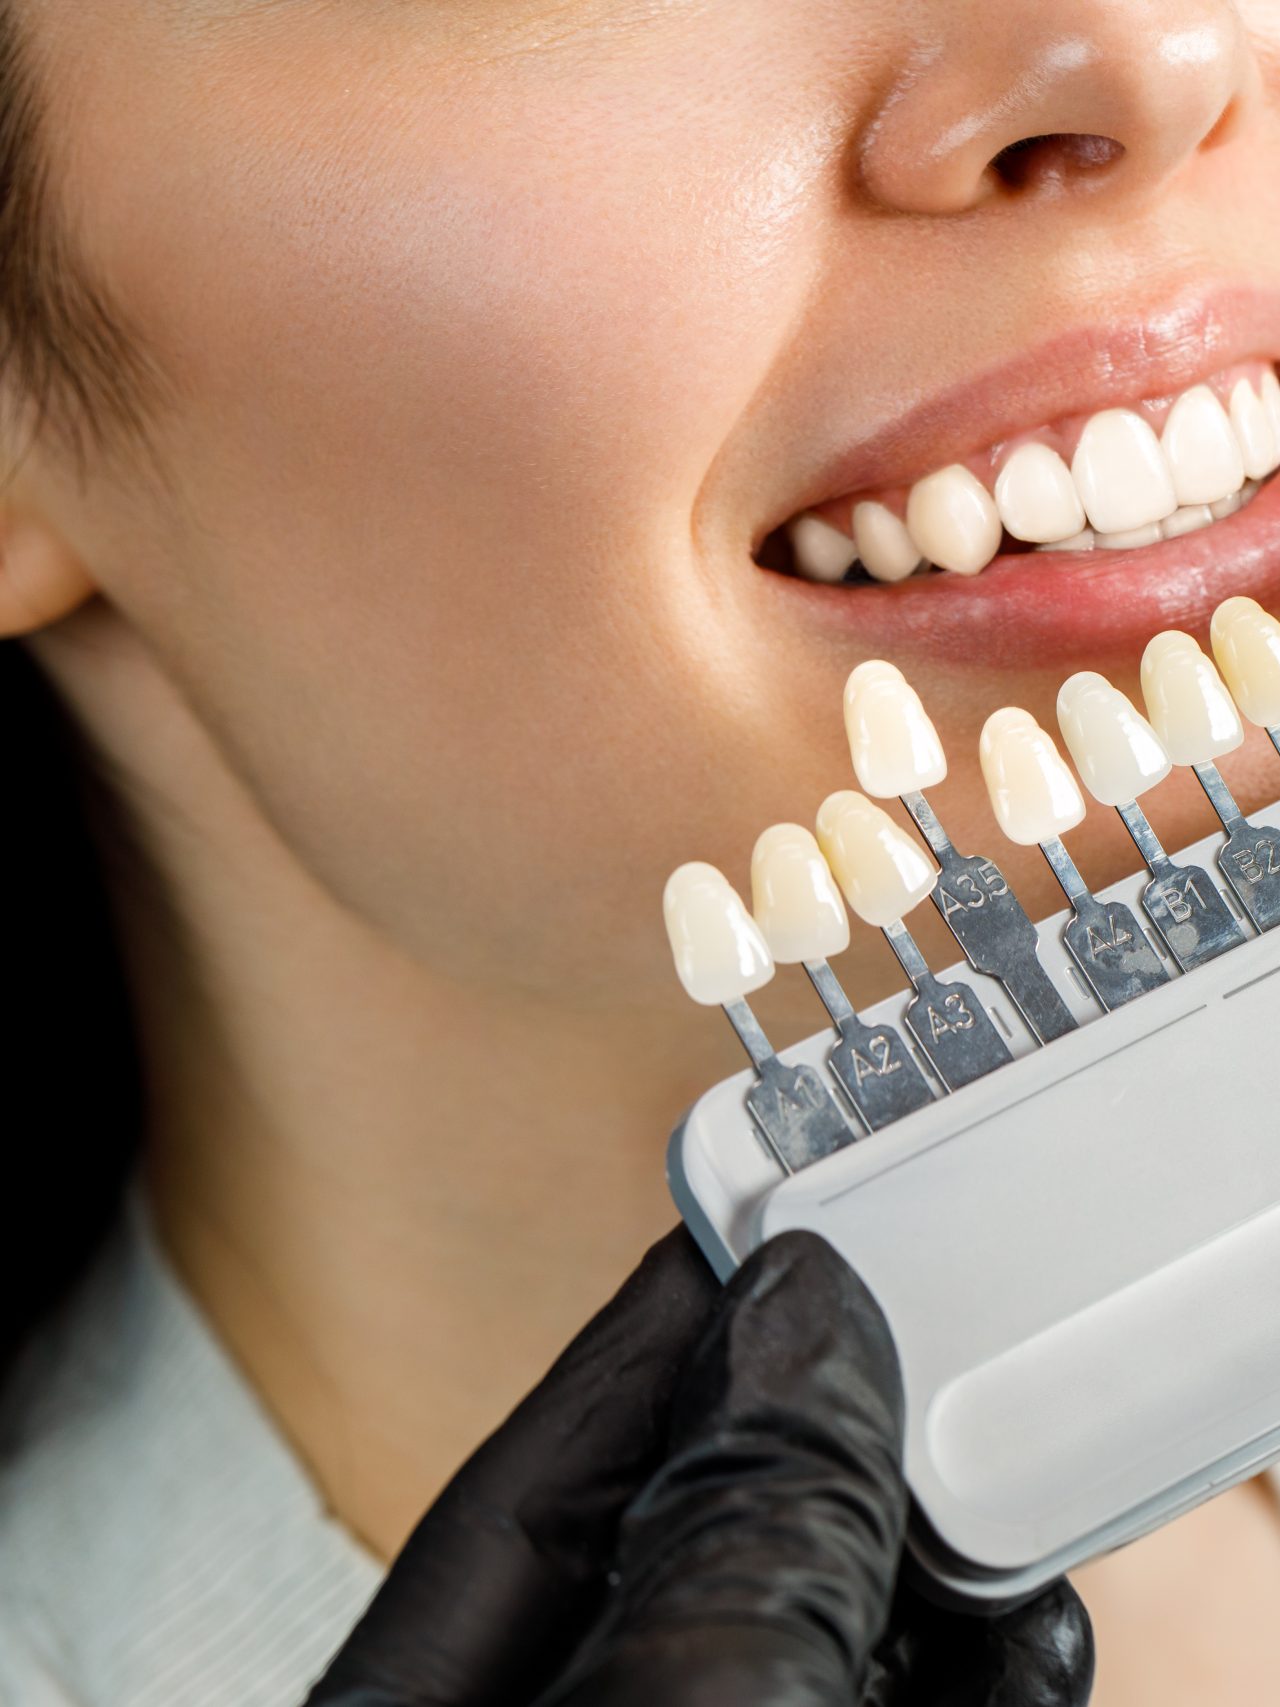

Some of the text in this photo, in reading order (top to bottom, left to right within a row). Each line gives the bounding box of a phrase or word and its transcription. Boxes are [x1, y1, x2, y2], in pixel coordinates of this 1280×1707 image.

[1160, 880, 1207, 924] B1
[1086, 915, 1134, 960] A4
[927, 994, 976, 1043] A3
[850, 1035, 901, 1086] A2
[774, 1074, 822, 1123] A1
